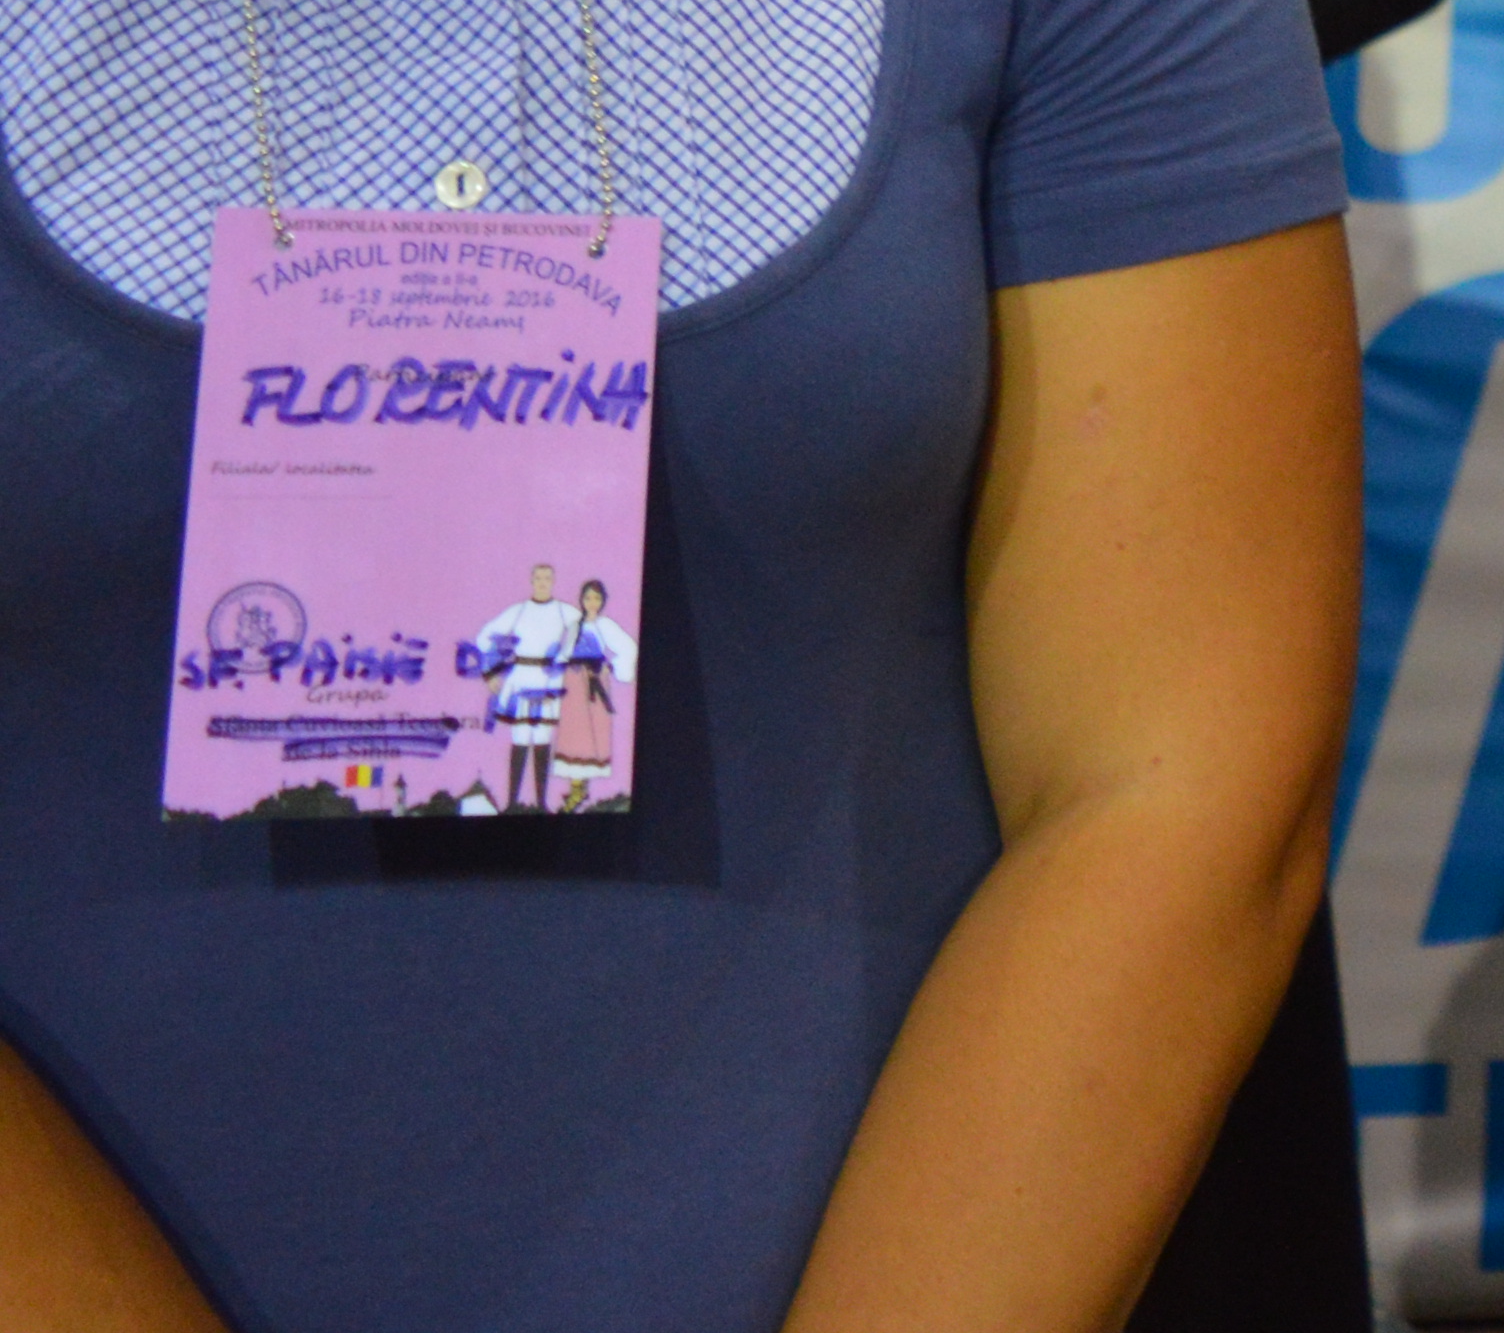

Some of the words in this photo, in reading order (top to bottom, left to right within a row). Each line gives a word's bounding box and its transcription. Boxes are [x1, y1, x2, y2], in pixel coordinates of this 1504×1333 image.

[252, 243, 391, 297] TÂNĂRUL
[400, 240, 449, 265] DIN
[458, 241, 622, 318] PETRODAVA
[318, 286, 383, 305] 16-18
[504, 289, 556, 309] 2016
[348, 307, 433, 329] Piatra
[305, 683, 389, 707] Grupa
